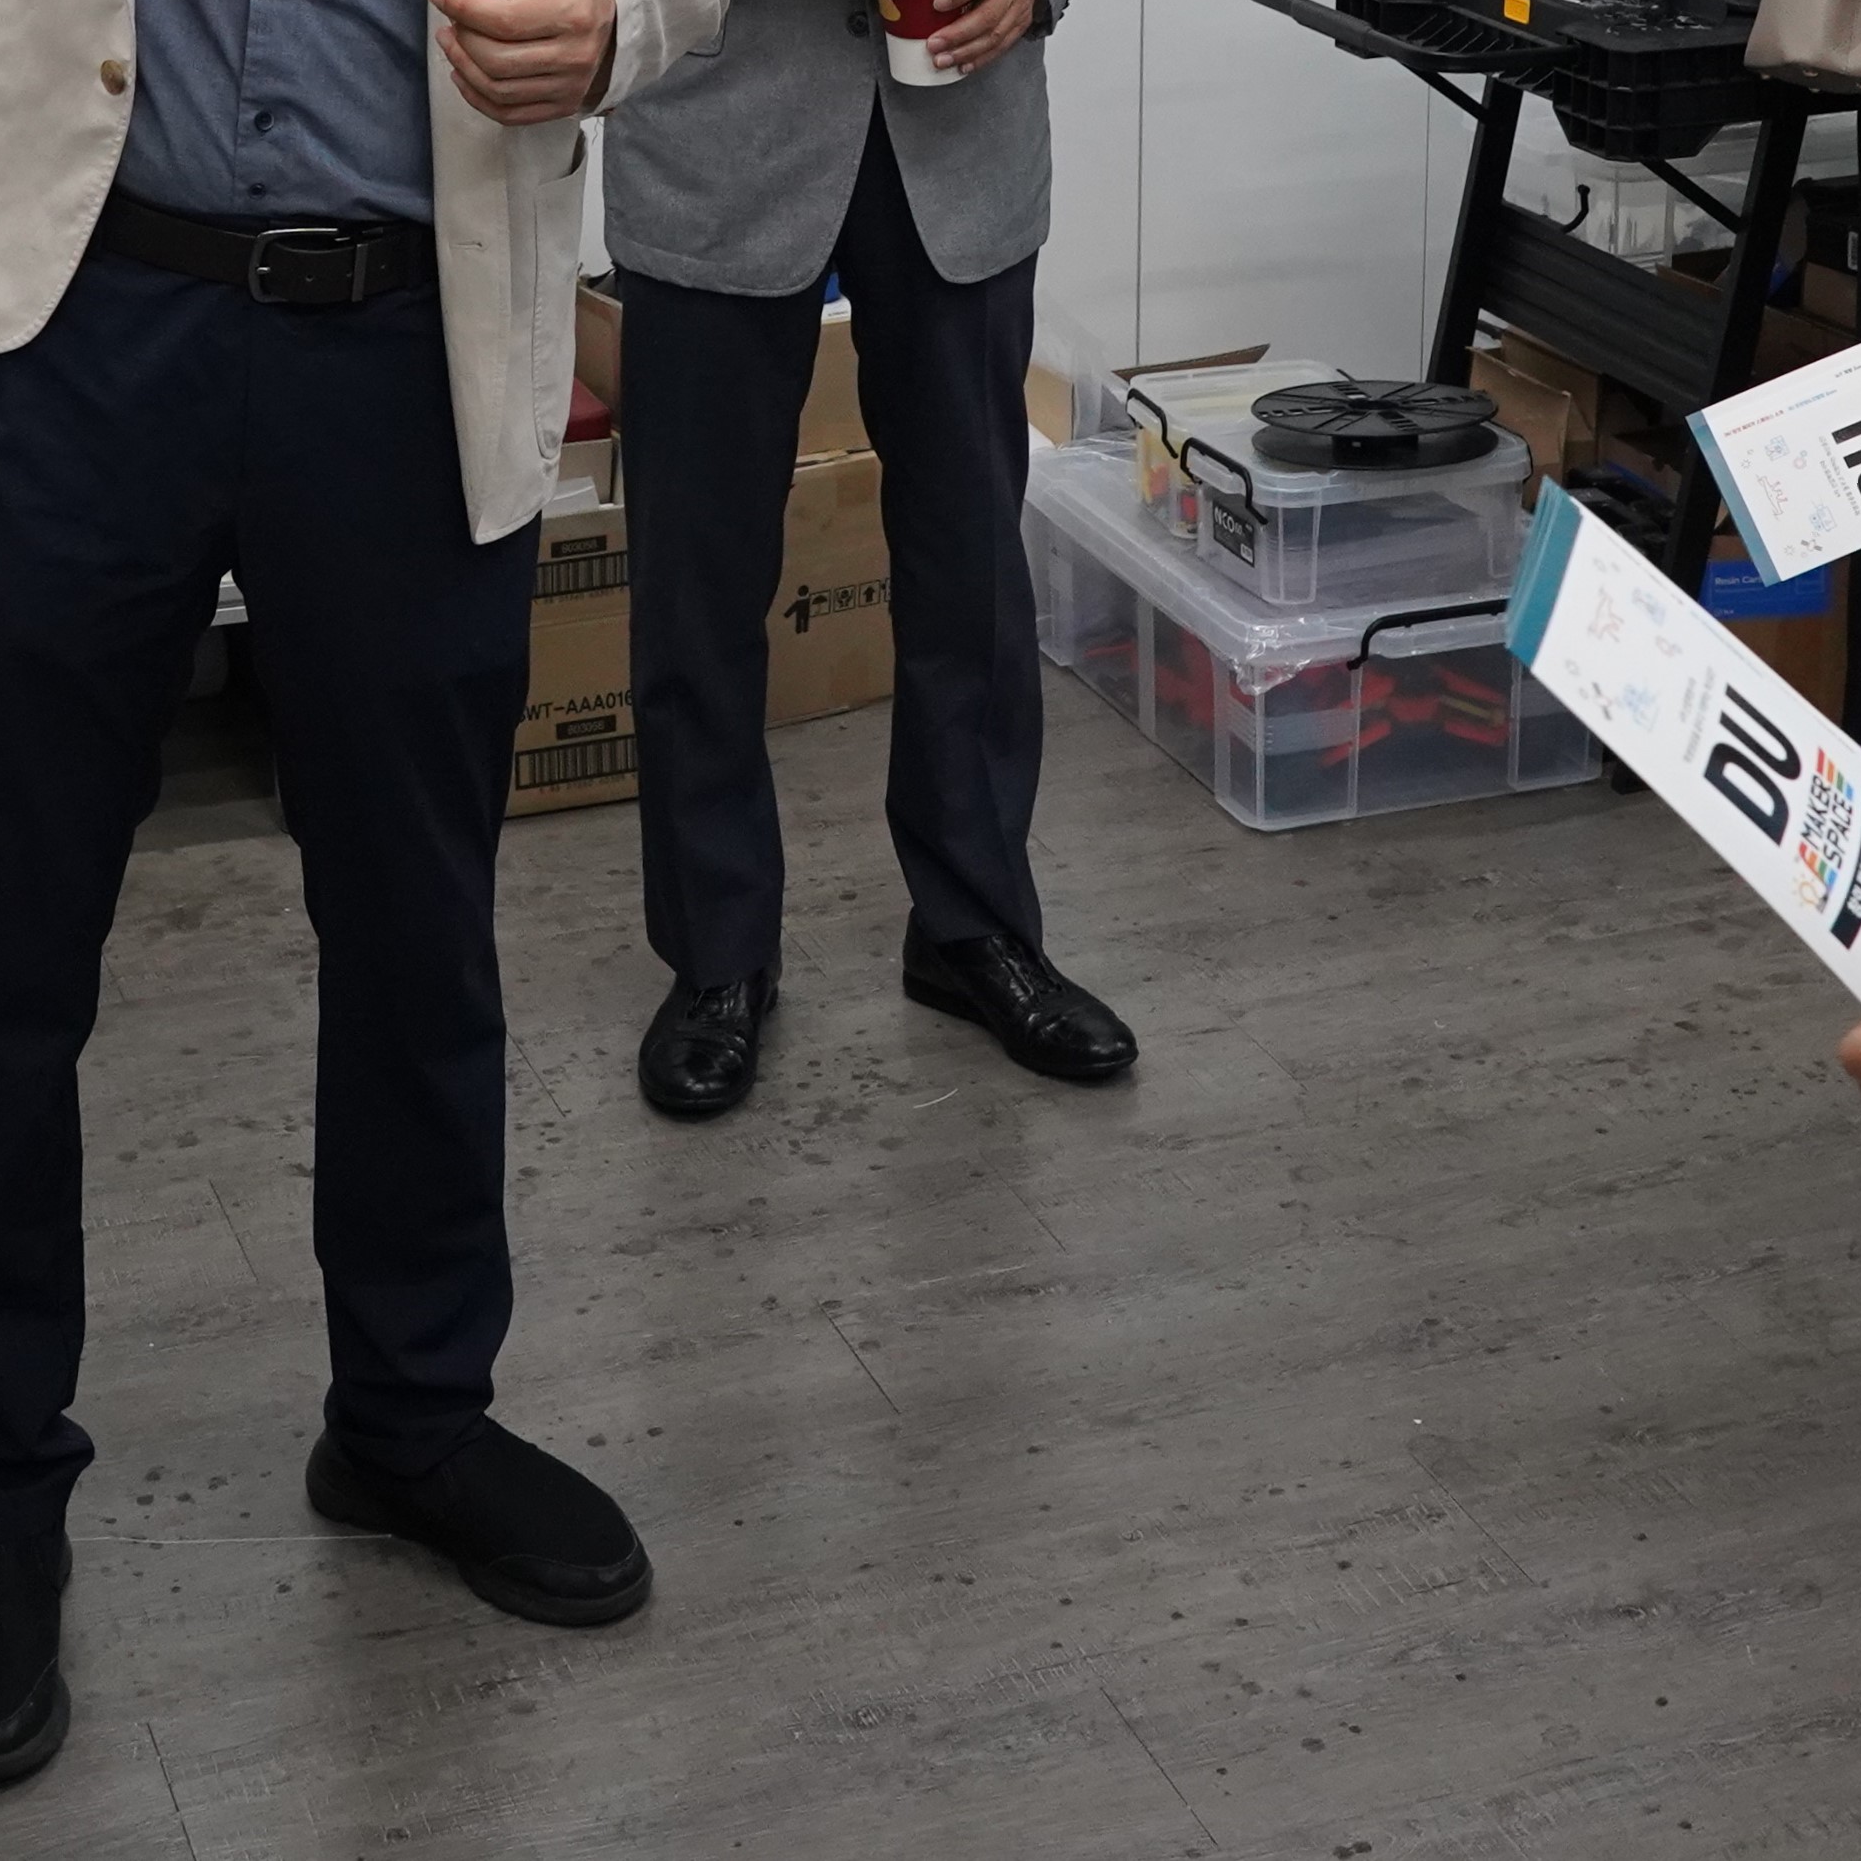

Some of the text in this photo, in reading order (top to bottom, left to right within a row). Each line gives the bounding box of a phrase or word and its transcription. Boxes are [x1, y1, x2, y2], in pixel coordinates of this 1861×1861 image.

[1715, 576, 1740, 586] Resin
[1704, 684, 1801, 847] DU
[1800, 775, 1832, 849] MAKER
[1823, 794, 1854, 869] SPACE
